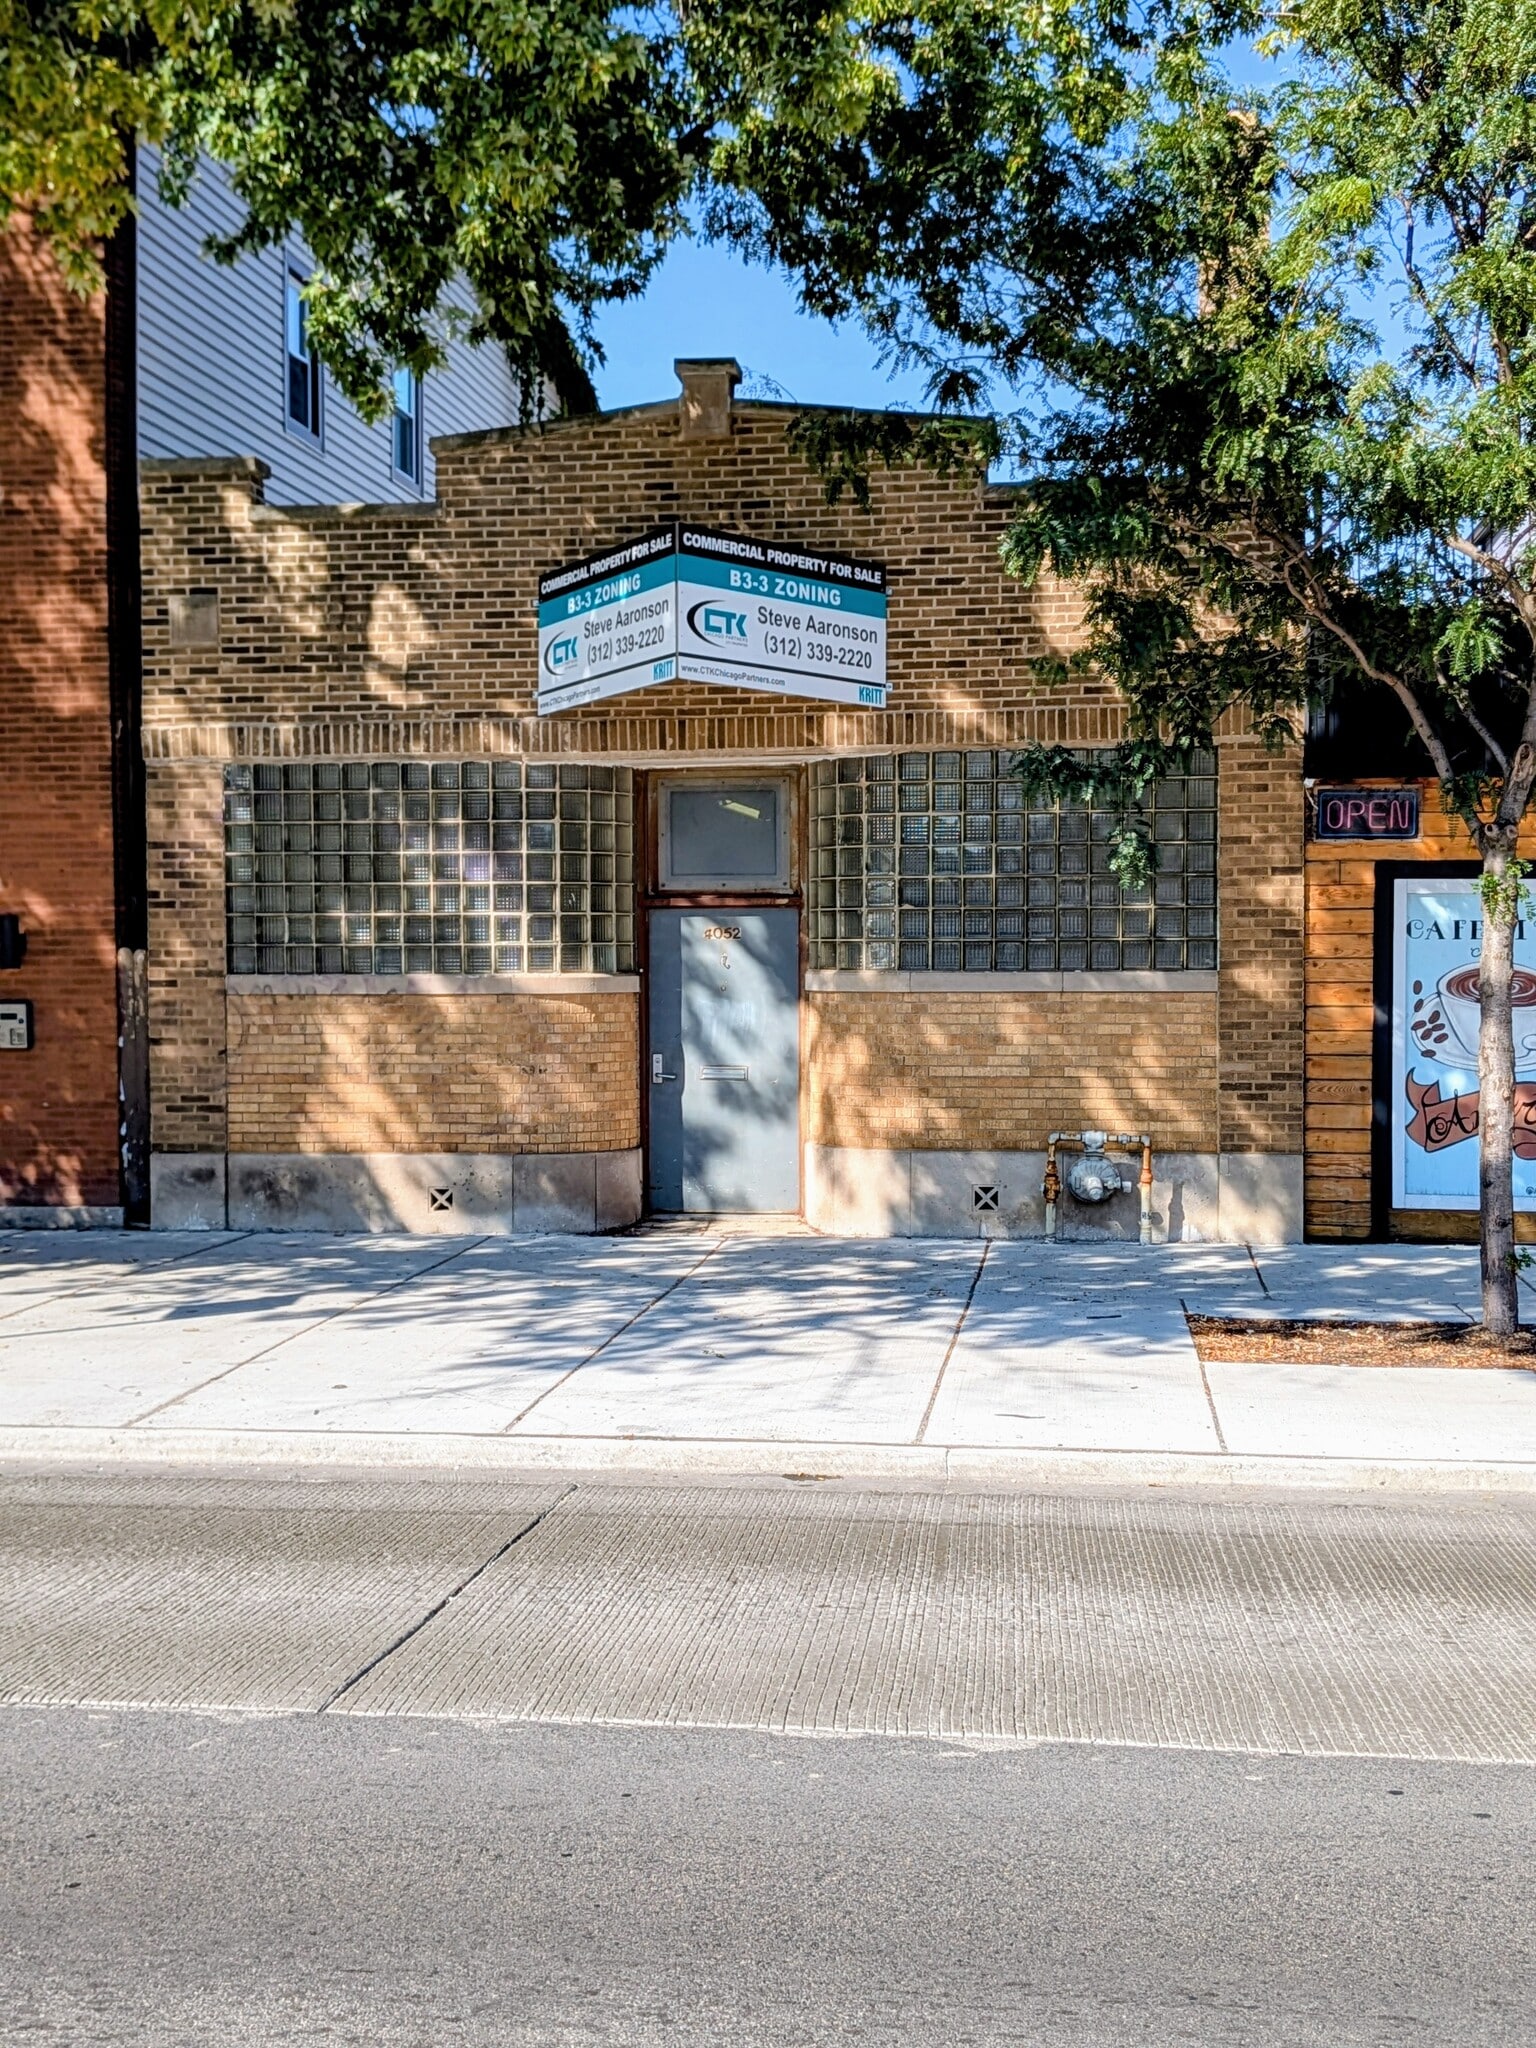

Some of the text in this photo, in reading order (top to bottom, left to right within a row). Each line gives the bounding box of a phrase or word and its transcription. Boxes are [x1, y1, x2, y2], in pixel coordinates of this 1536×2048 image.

[541, 533, 673, 594] COMMERCIAL PROPERTY FOR SALE
[683, 532, 882, 584] COMMERCIAL PROPERTY FOR SALE
[567, 573, 641, 615] B3-3 ZONING
[729, 569, 841, 606] B3-3 ZONING
[583, 599, 669, 639] Steve Aaronson
[704, 608, 747, 638] CTK
[757, 606, 878, 644] Steve Aaronson
[553, 636, 578, 666] CTK
[587, 625, 665, 666] (312) 339-2220
[764, 631, 872, 669] (312) 339-2220
[653, 659, 674, 682] KRITT
[681, 665, 785, 687] www.CTKChicagoPartners.com
[859, 686, 884, 705] KRITT
[1327, 800, 1409, 829] OPEN
[704, 927, 742, 939] 4052
